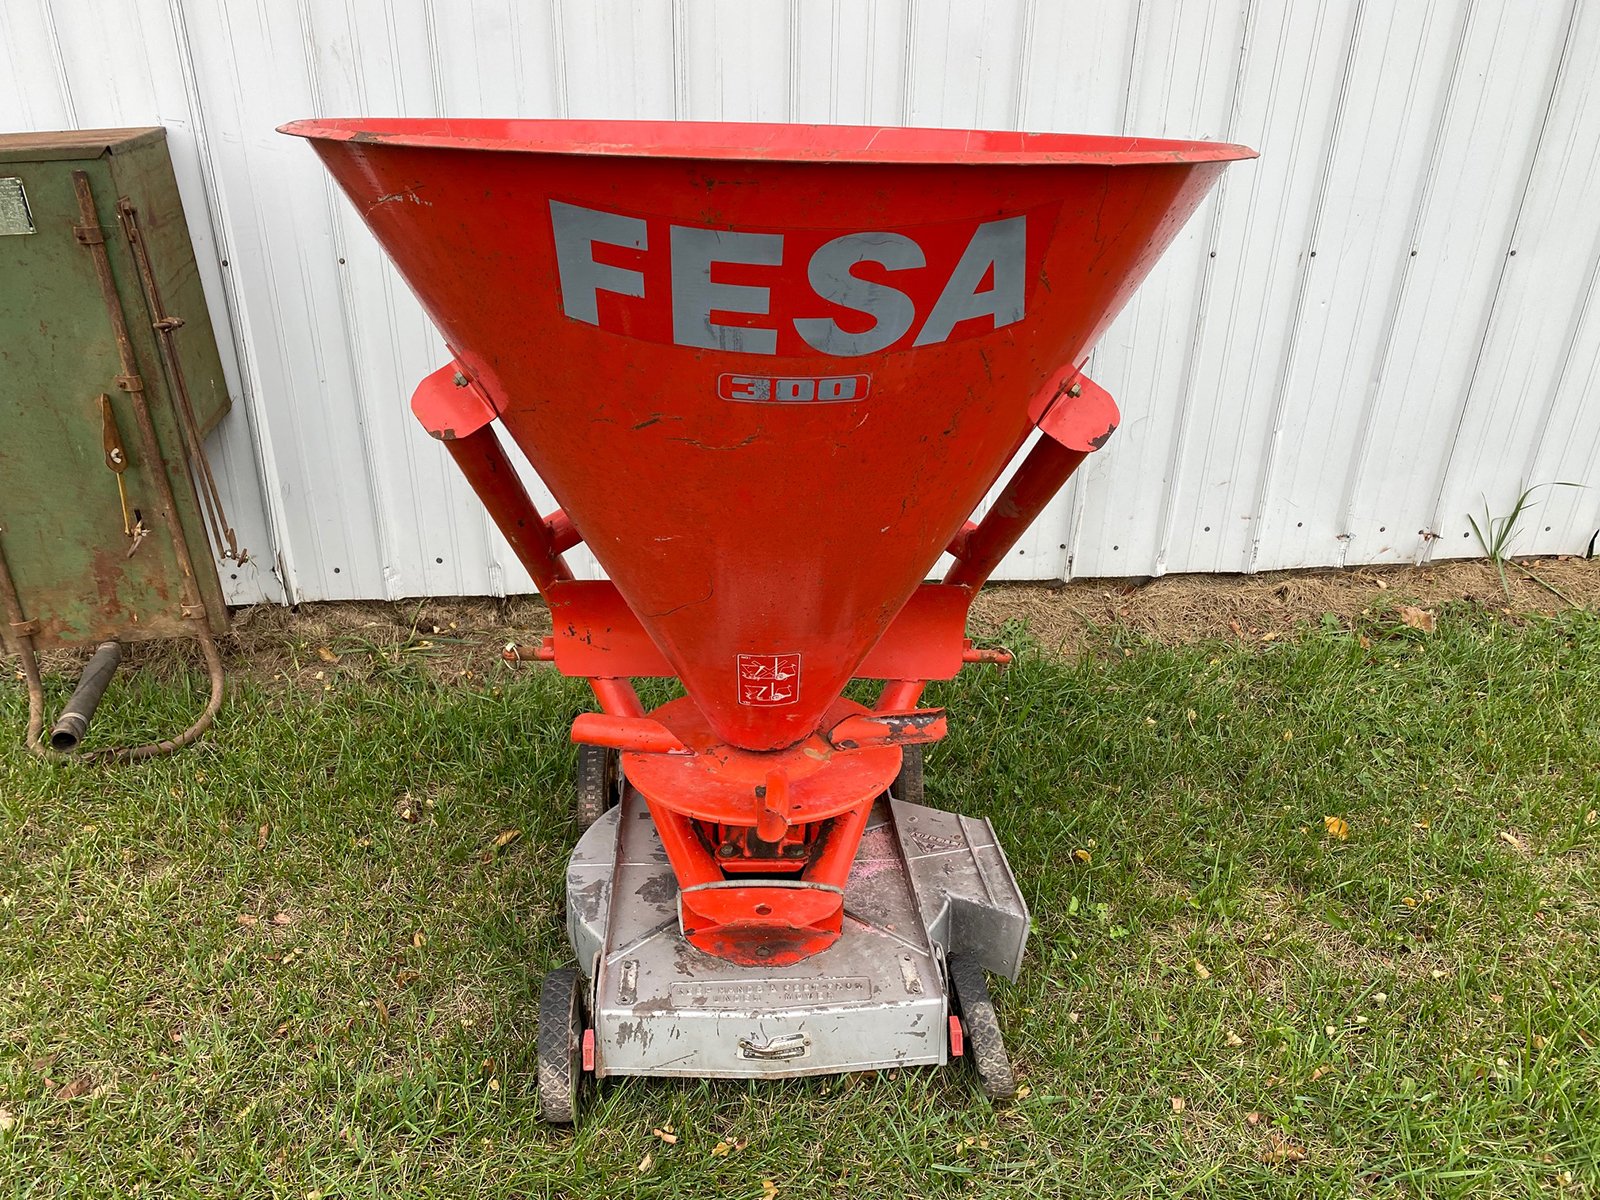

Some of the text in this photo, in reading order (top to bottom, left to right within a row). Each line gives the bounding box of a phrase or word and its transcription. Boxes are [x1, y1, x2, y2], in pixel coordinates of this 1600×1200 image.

[549, 199, 1026, 356] FESA
[732, 377, 857, 401] 300
[718, 985, 763, 995] HANDS
[713, 994, 761, 1004] UNDER
